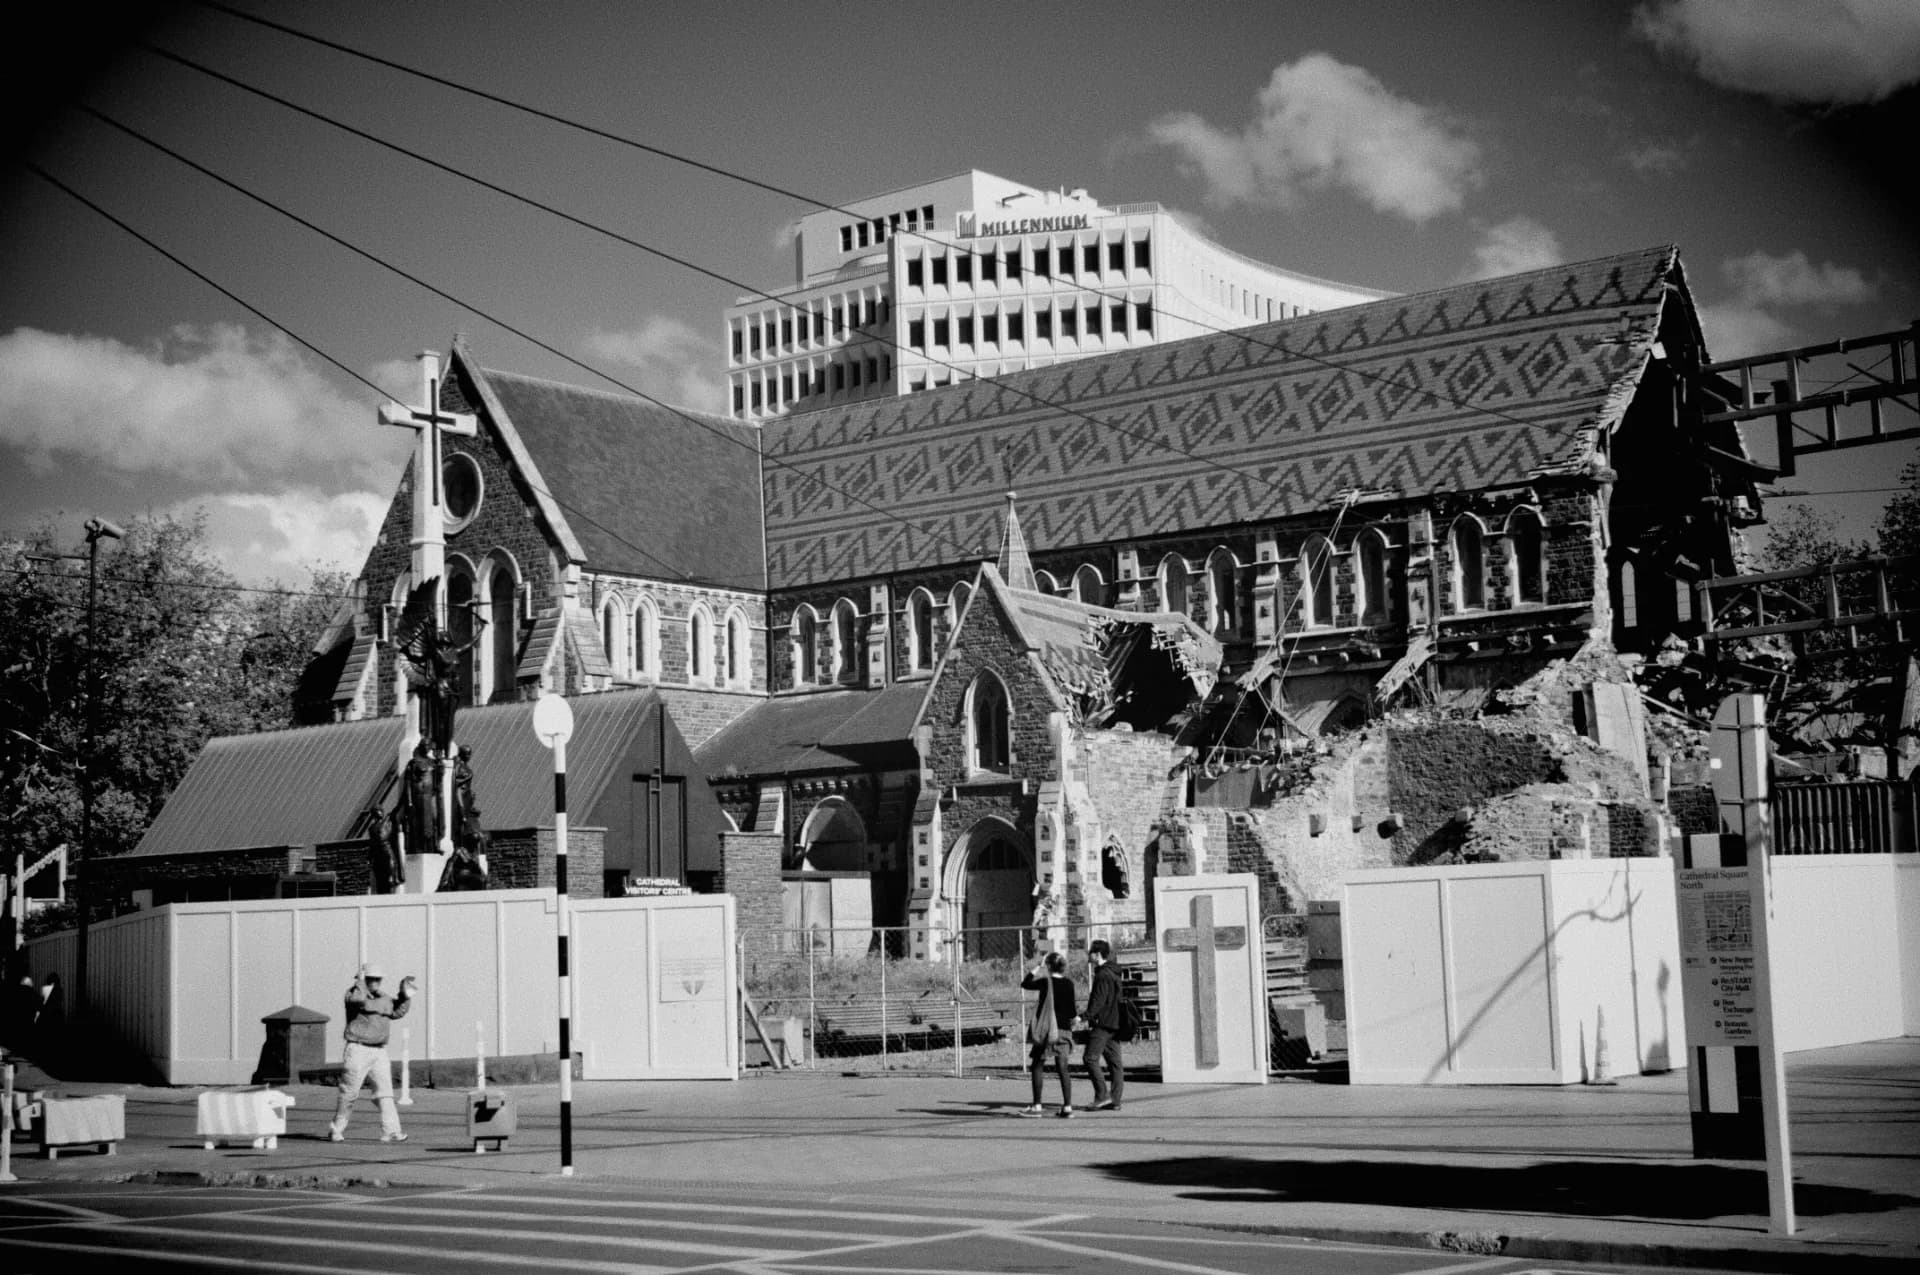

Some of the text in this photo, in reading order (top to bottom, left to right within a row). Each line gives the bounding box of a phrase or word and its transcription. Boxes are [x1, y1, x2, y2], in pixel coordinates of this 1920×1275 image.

[981, 213, 1087, 236] MILLENNIUM
[1680, 871, 1719, 881] Cathedral
[636, 878, 680, 887] CATHEDRAL
[1680, 881, 1704, 890] North
[1721, 985, 1734, 993] City
